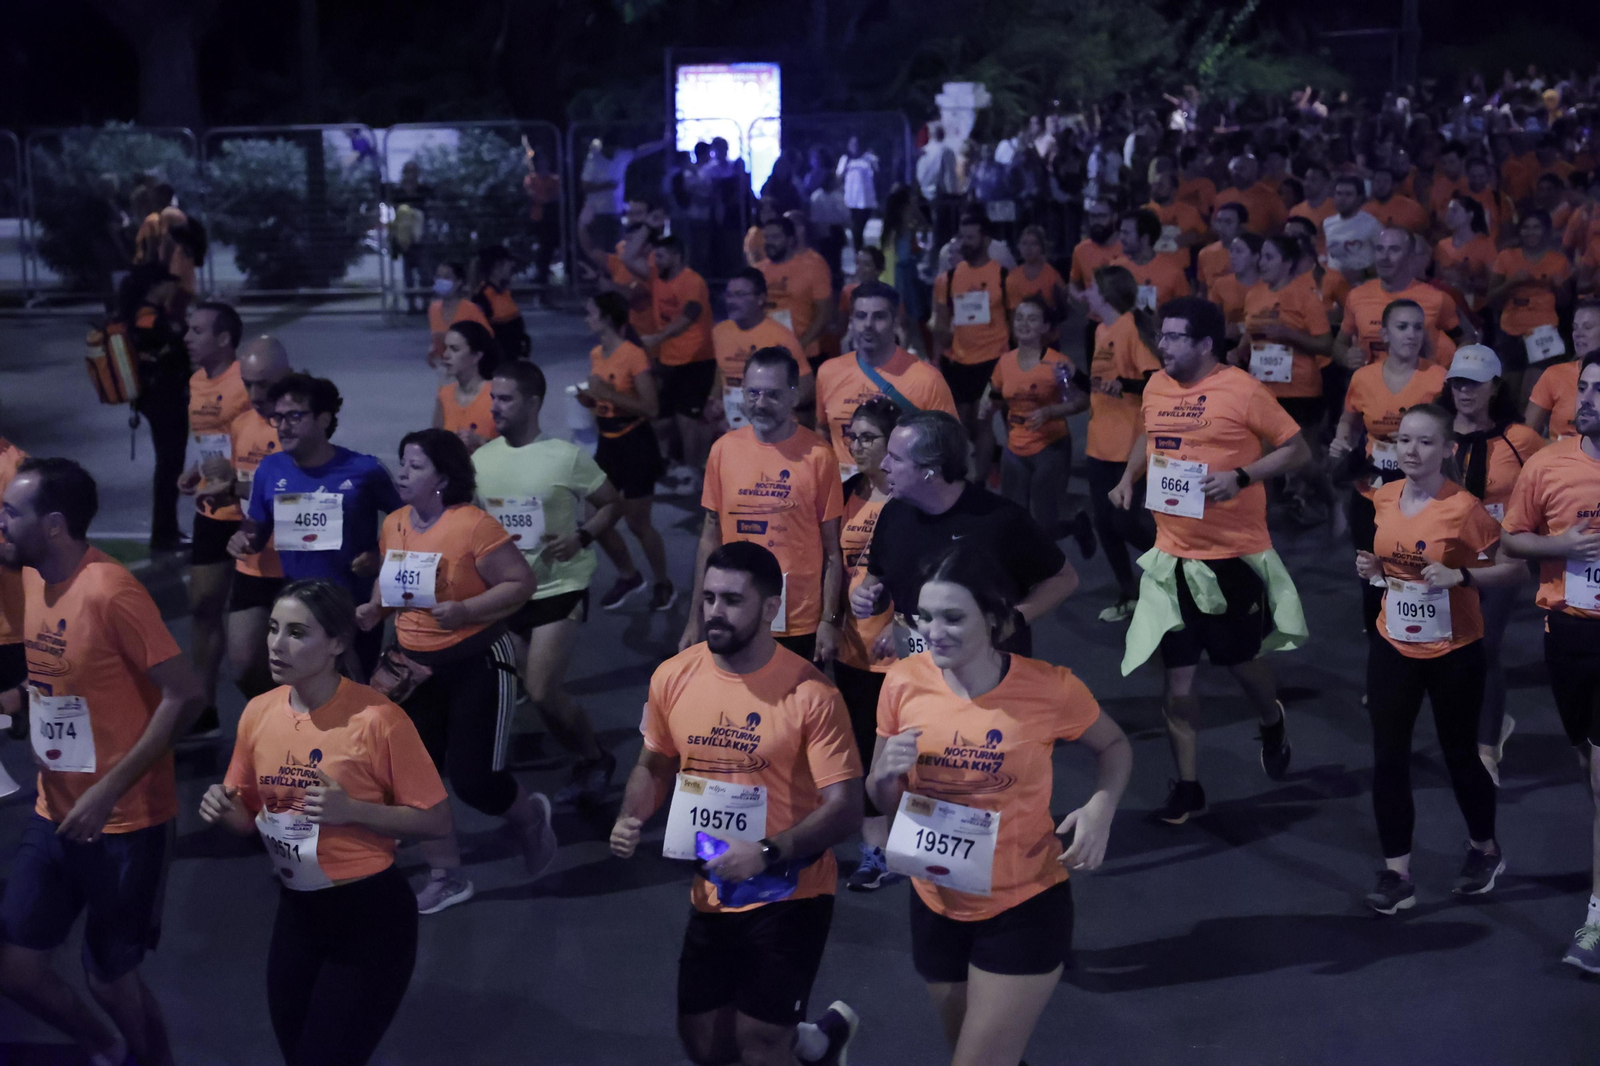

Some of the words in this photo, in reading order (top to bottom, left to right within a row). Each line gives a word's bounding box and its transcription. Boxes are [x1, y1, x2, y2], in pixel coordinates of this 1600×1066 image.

[755, 482, 792, 491] NOCTURNA
[1161, 476, 1190, 493] 6664
[738, 488, 770, 497] SEVILLA
[294, 512, 327, 527] 4650
[499, 514, 533, 527] 13588
[1392, 551, 1426, 562] NOCTURN
[394, 569, 421, 585] 4651
[1396, 600, 1436, 618] 10919
[687, 735, 734, 749] SEVILLA
[710, 726, 761, 743] NOCTURNA
[943, 746, 1005, 761] NOCTURNA
[917, 754, 969, 770] SEVILLA
[278, 765, 319, 780] NOCTURN
[259, 775, 297, 788] SEVILLA
[690, 806, 747, 831] 19576
[916, 828, 976, 860] 19577
